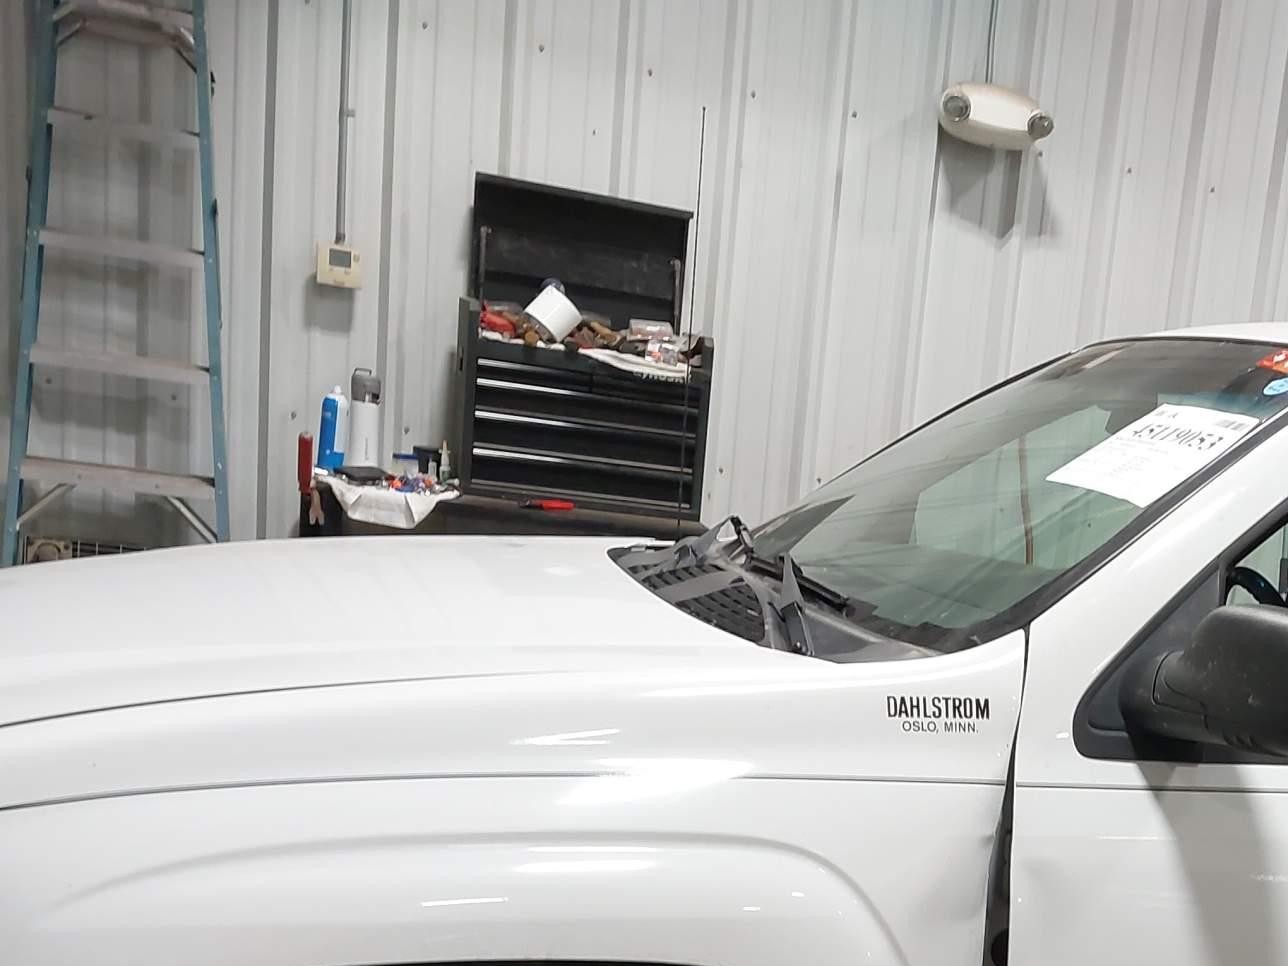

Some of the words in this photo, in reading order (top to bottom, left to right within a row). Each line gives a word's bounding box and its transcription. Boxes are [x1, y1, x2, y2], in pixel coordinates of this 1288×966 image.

[886, 695, 990, 720] DAHLSTROM
[902, 720, 939, 734] OSLO,
[943, 721, 979, 735] MINN.
